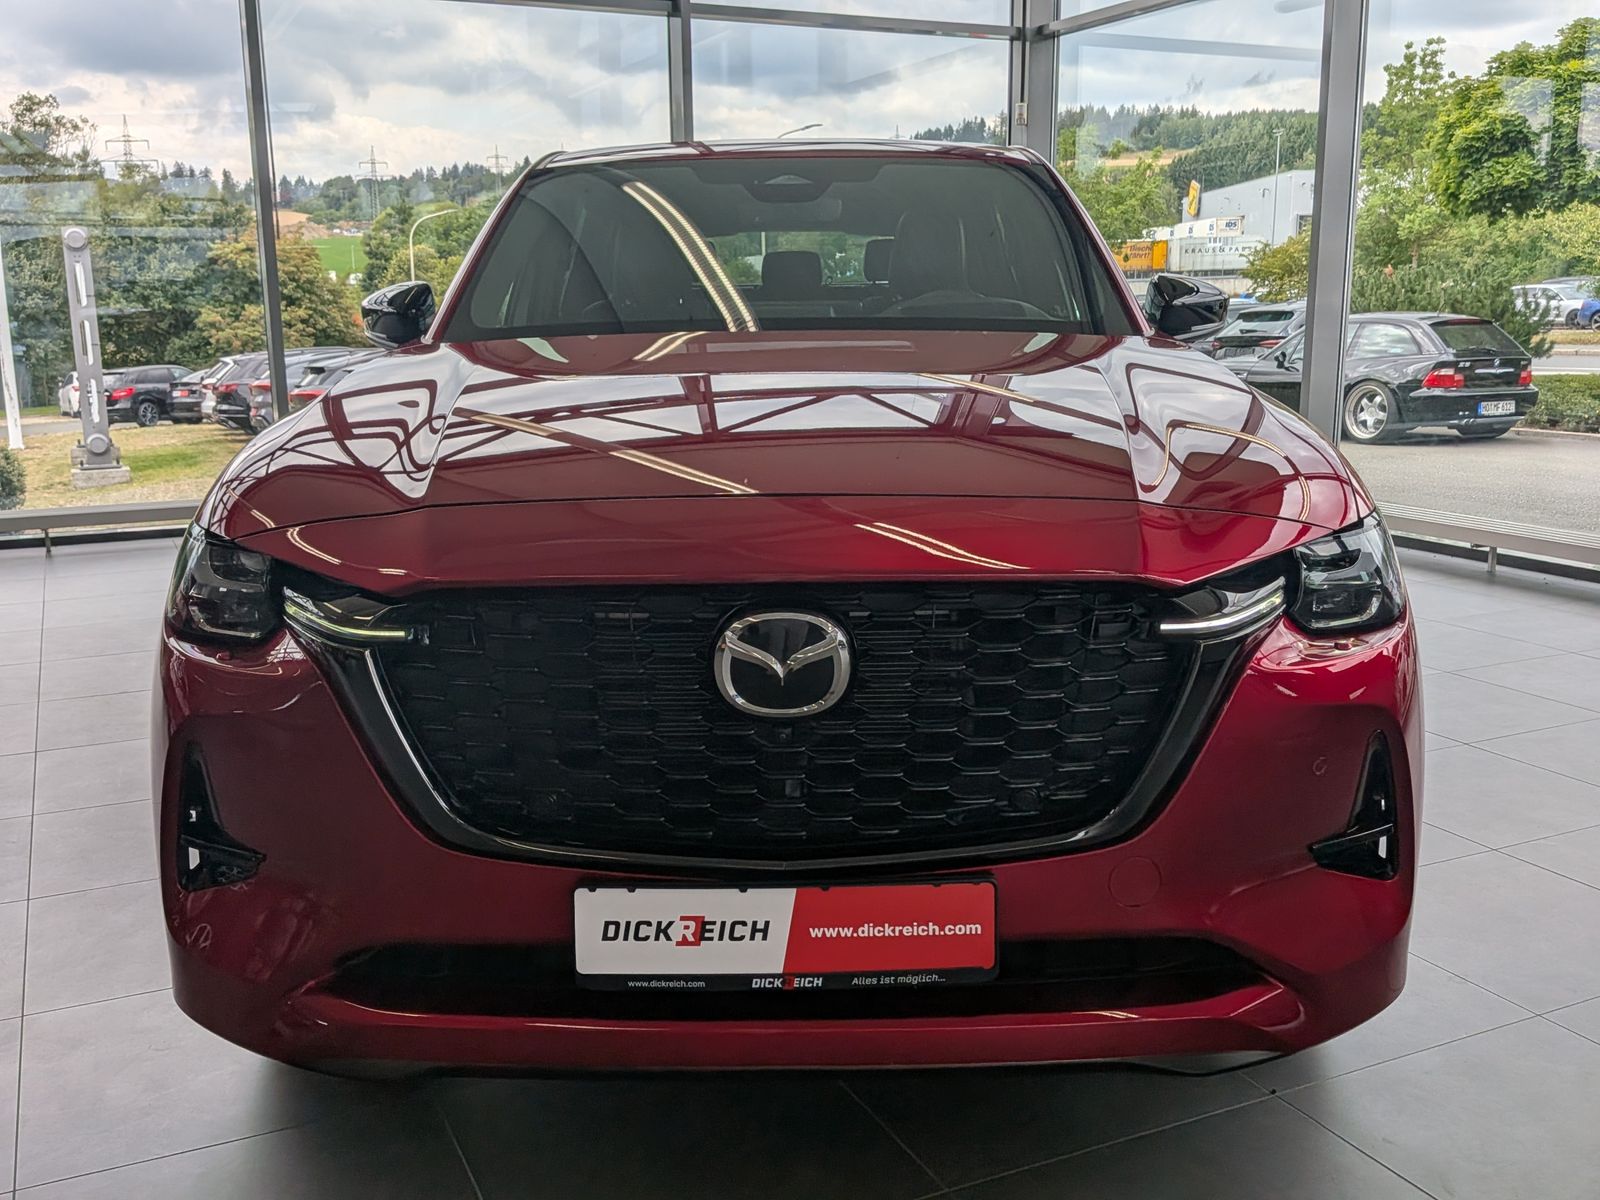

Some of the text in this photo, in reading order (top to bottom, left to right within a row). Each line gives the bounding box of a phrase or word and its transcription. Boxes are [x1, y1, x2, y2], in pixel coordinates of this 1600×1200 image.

[1219, 245, 1225, 253] &
[601, 918, 770, 944] DICKREICH
[809, 922, 982, 938] www.dickreich.com
[627, 980, 706, 988] www.dickreich.com
[852, 973, 946, 985] Alles ist möglich...
